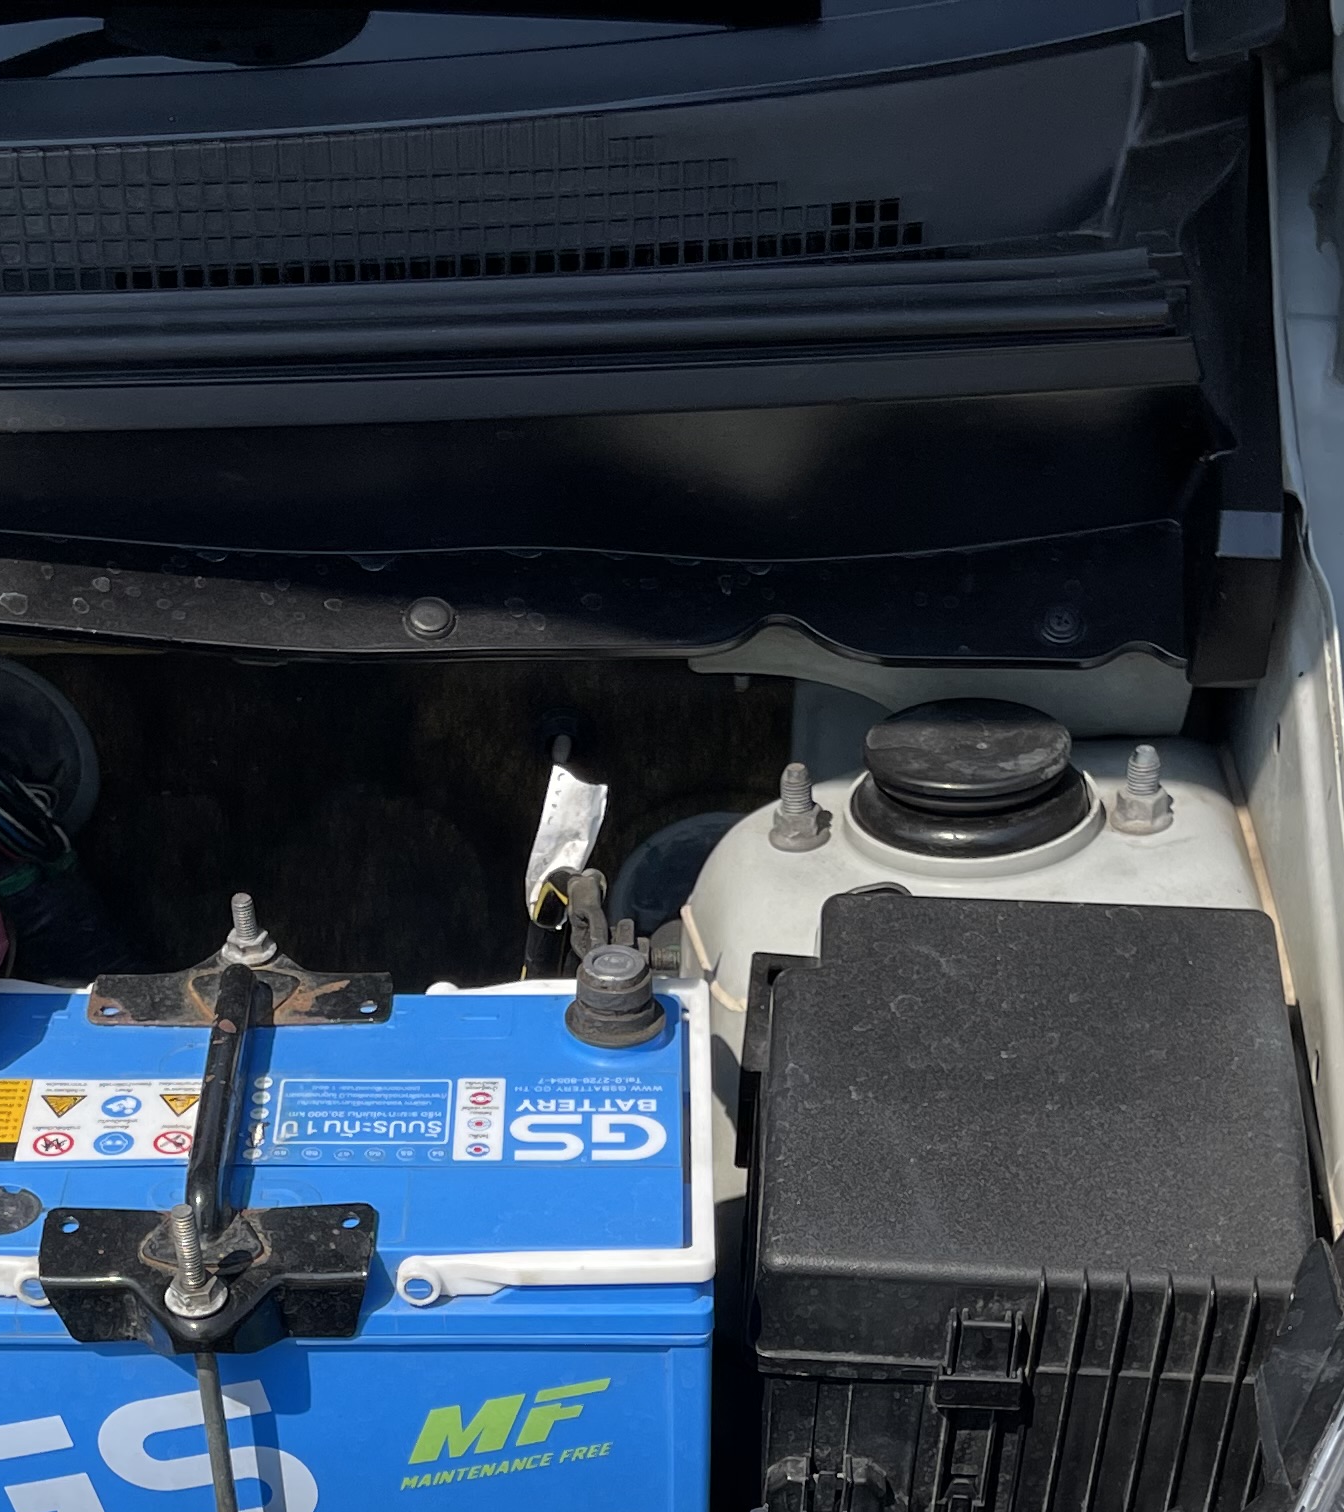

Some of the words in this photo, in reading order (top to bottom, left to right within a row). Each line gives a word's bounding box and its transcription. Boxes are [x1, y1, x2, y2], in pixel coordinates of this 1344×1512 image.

[516, 1099, 657, 1112] BATTERY
[279, 1120, 299, 1138] ปี
[307, 1121, 317, 1135] 1
[323, 1120, 443, 1138] รับประกัน
[509, 1114, 667, 1161] GS
[408, 1378, 611, 1465] MF
[400, 1453, 554, 1491] MAINTENANCE
[559, 1442, 613, 1464] FREE
